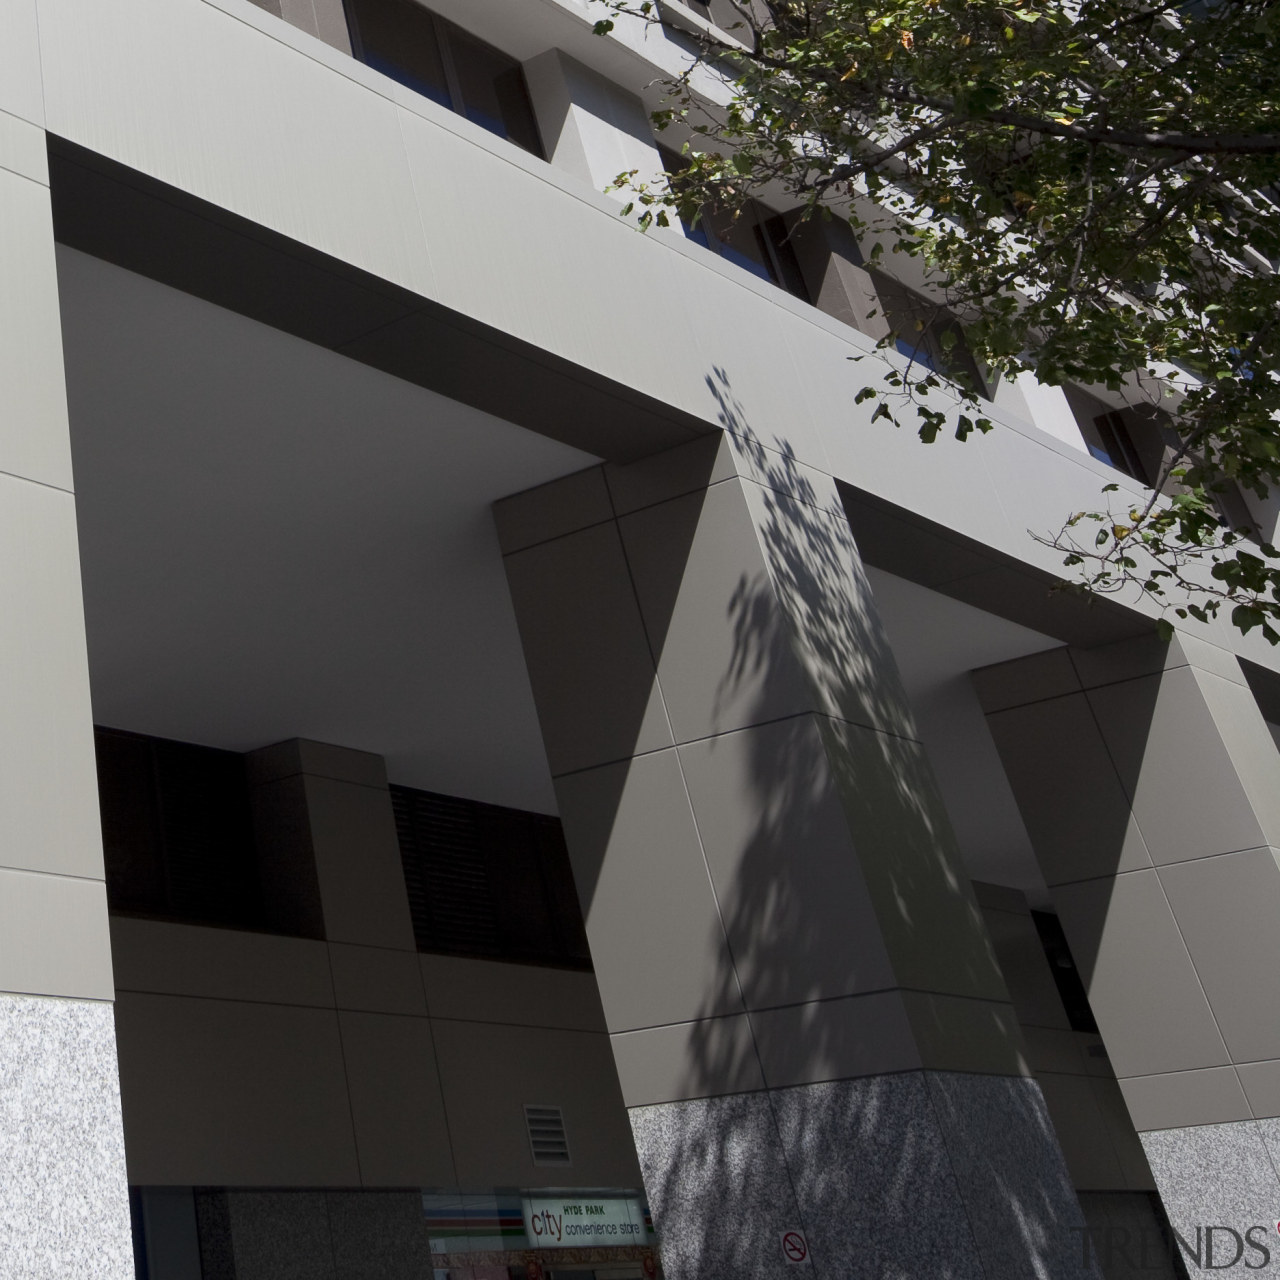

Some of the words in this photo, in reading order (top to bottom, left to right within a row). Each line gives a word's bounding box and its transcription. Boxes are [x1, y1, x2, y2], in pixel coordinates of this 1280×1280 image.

[563, 1205, 582, 1215] HYDE
[585, 1204, 605, 1215] PARK
[531, 1209, 562, 1241] city
[566, 1222, 617, 1235] convenience
[619, 1223, 640, 1234] store
